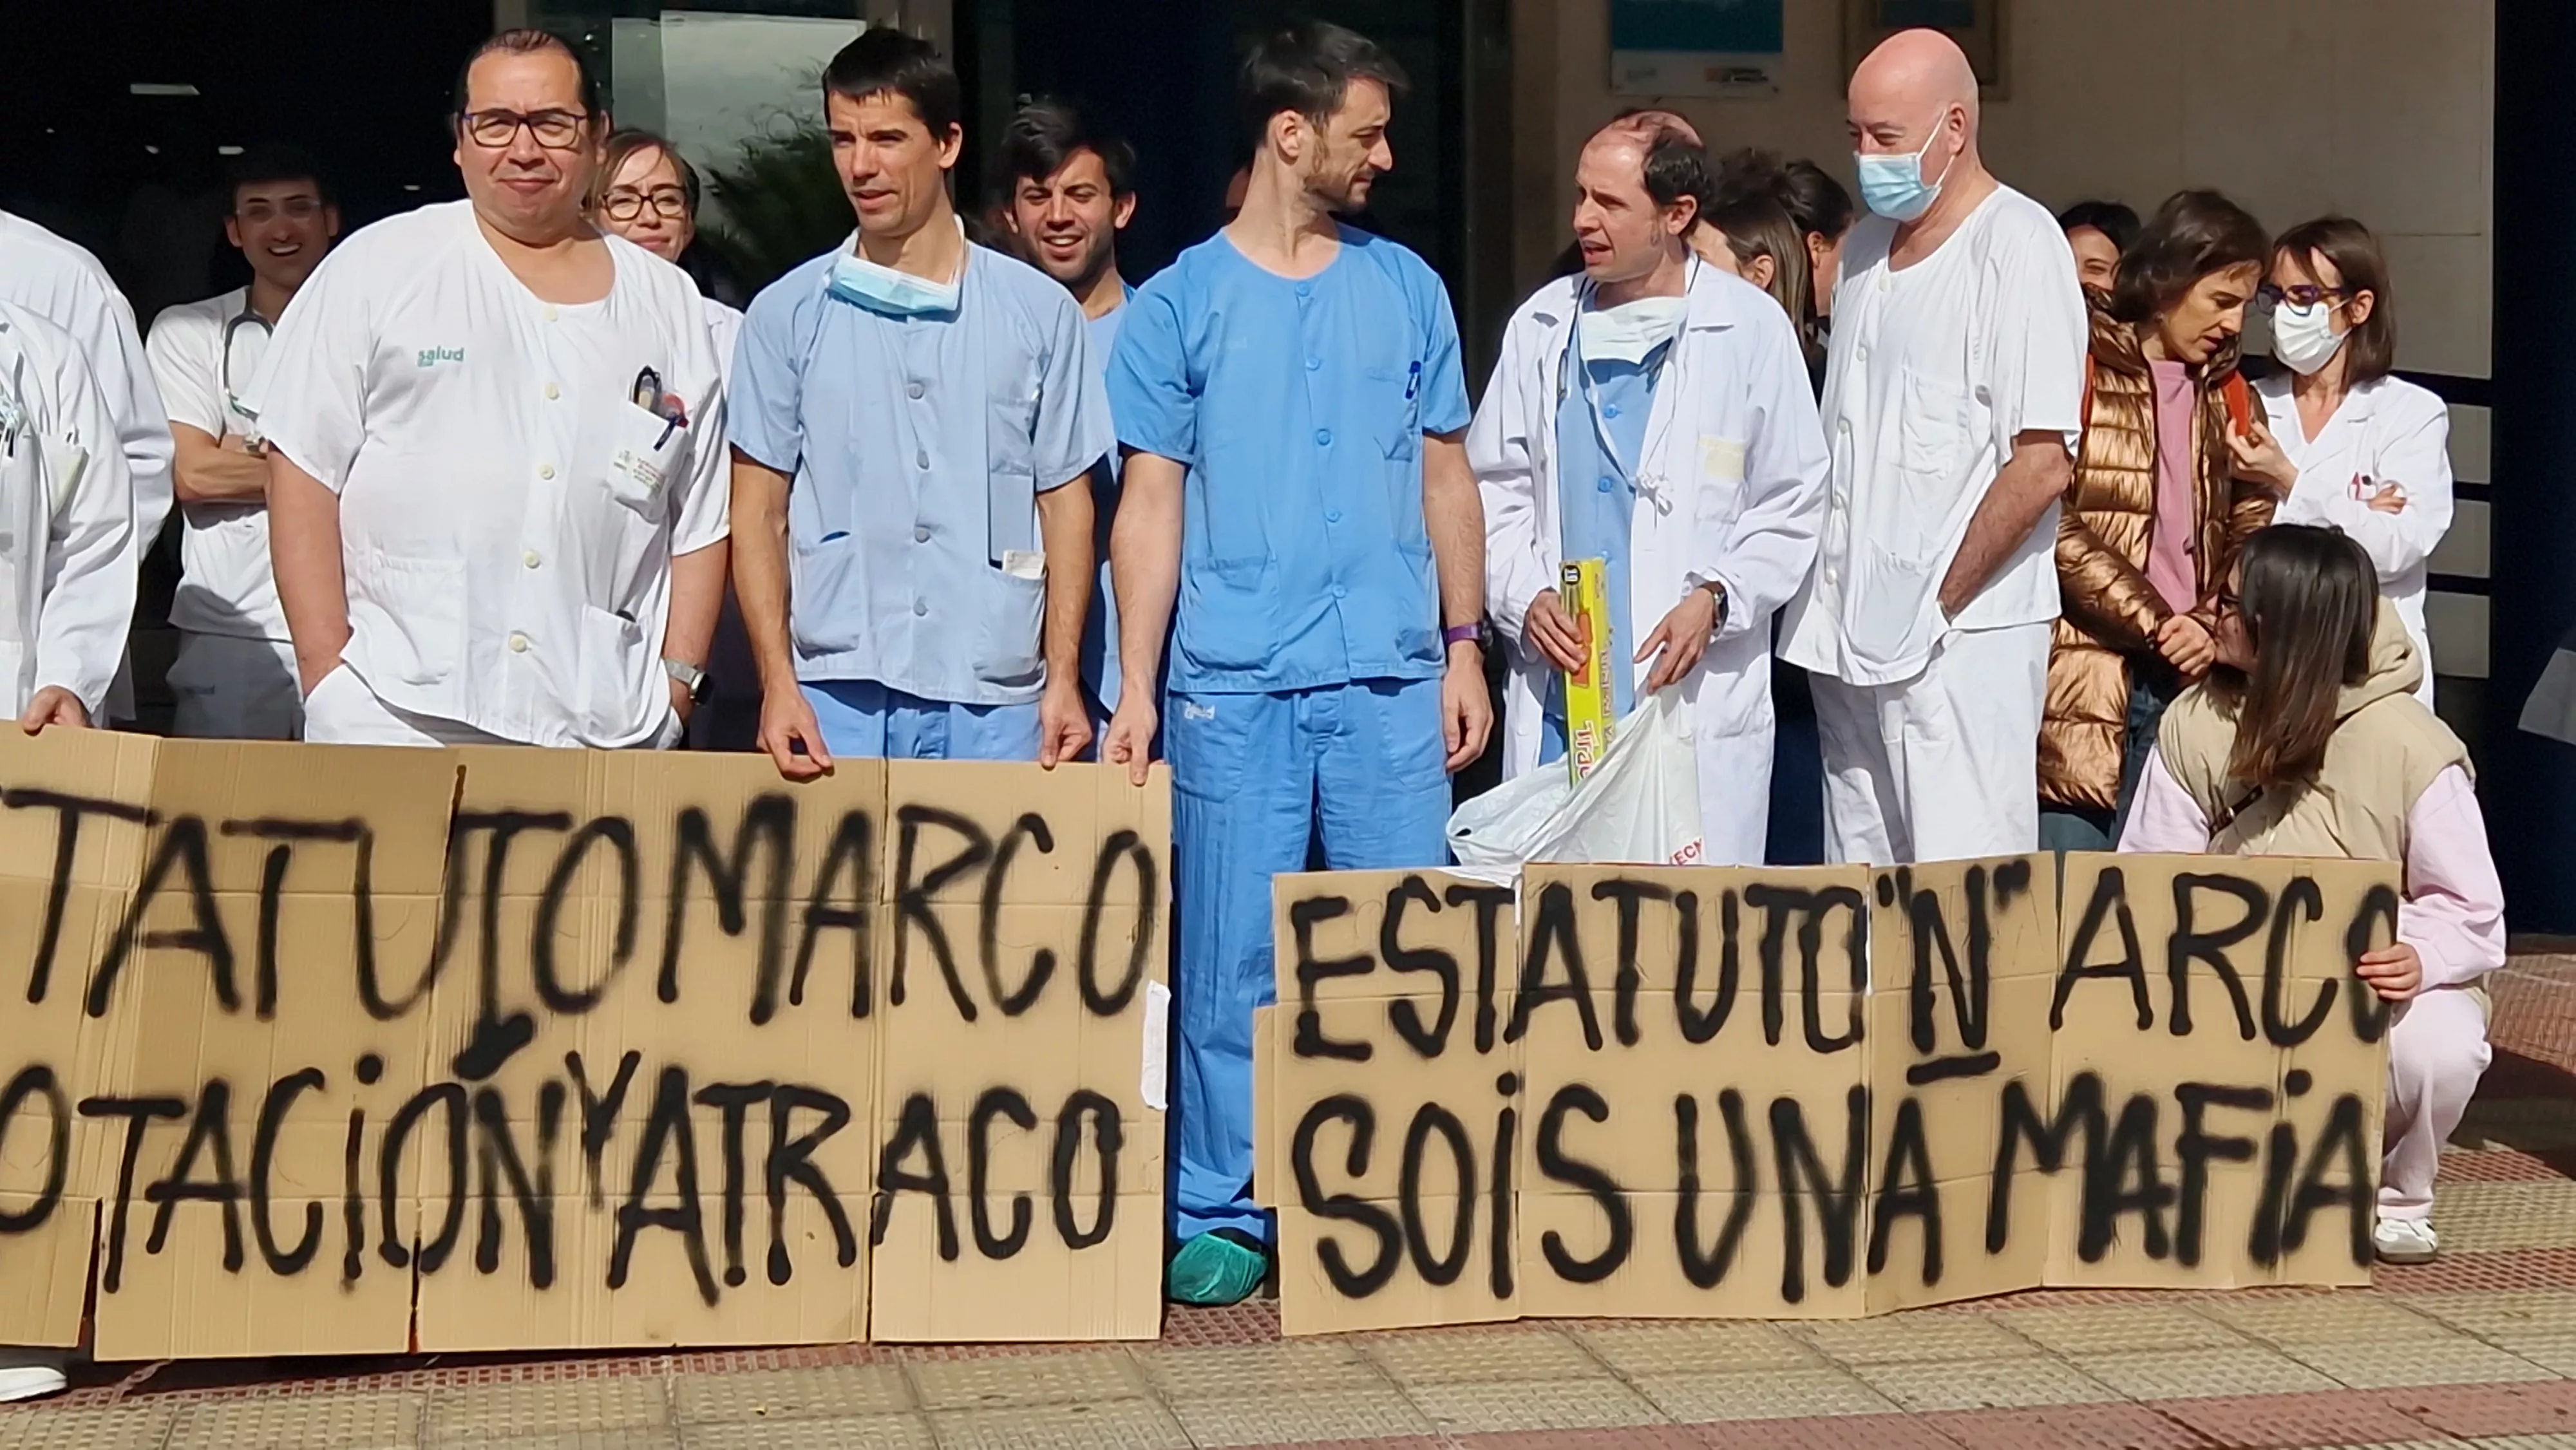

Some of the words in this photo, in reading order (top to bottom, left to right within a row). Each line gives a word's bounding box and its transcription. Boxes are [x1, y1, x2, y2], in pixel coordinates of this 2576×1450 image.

[417, 345, 464, 363] salud
[657, 791, 1157, 1025] MARCO
[1290, 874, 1867, 1060] ESTATUTO
[605, 1065, 1122, 1307] ATRACO
[1674, 1084, 1943, 1304] UNA
